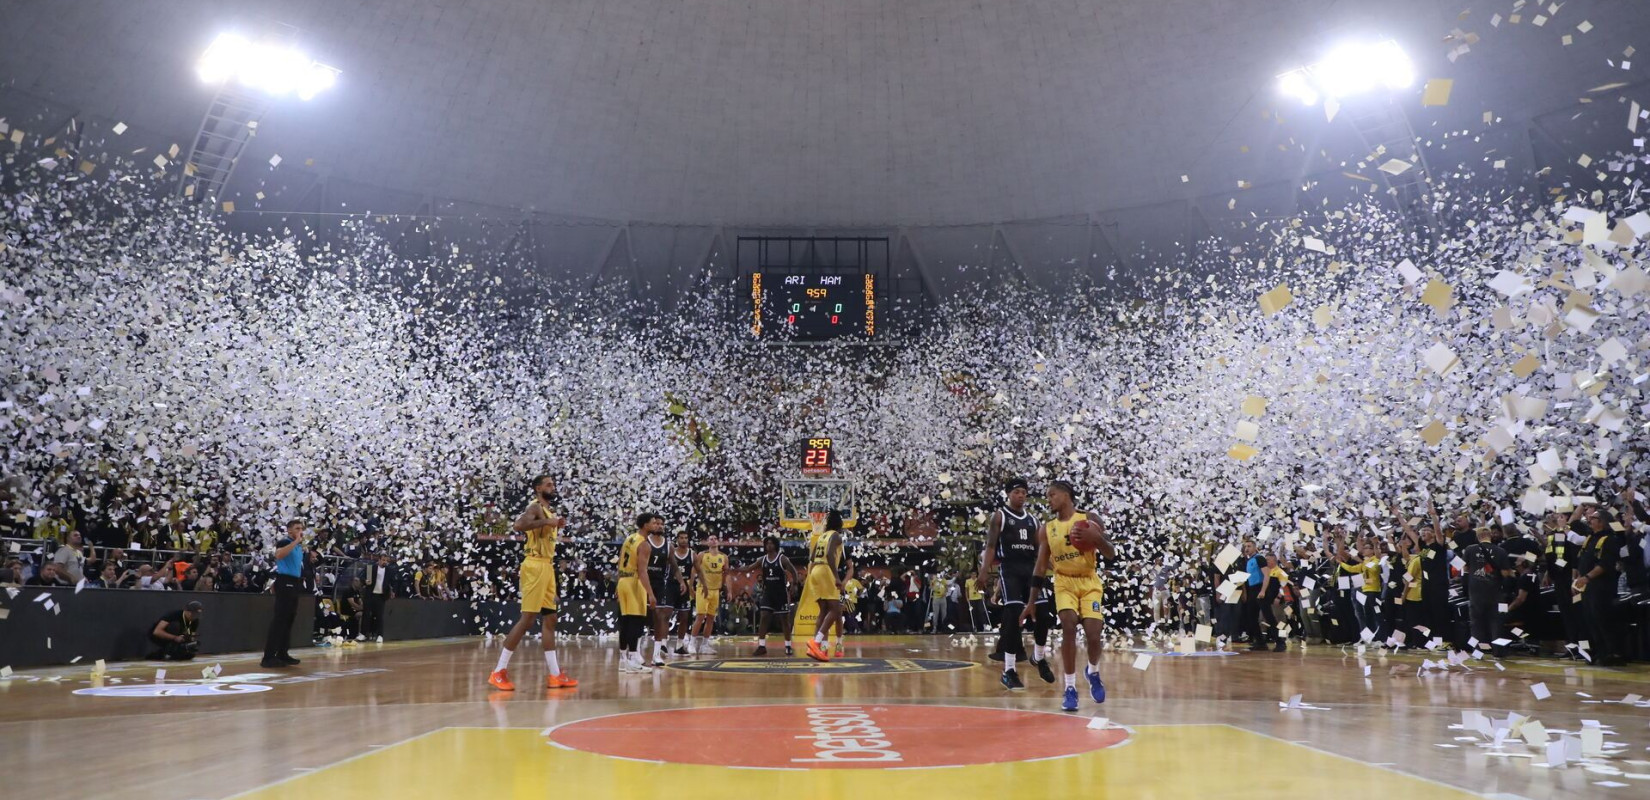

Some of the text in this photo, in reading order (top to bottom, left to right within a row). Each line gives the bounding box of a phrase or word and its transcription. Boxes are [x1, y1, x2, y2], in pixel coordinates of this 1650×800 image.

[785, 276, 842, 285] ARI HAM
[792, 303, 801, 313] 0
[835, 303, 843, 313] 0
[788, 315, 795, 324] 0
[831, 315, 838, 324] 0
[809, 439, 831, 449] 9:59
[805, 450, 828, 465] 23
[1019, 528, 1028, 540] 19
[653, 555, 659, 565] 7
[769, 568, 774, 576] 2
[790, 706, 904, 763] betsson
